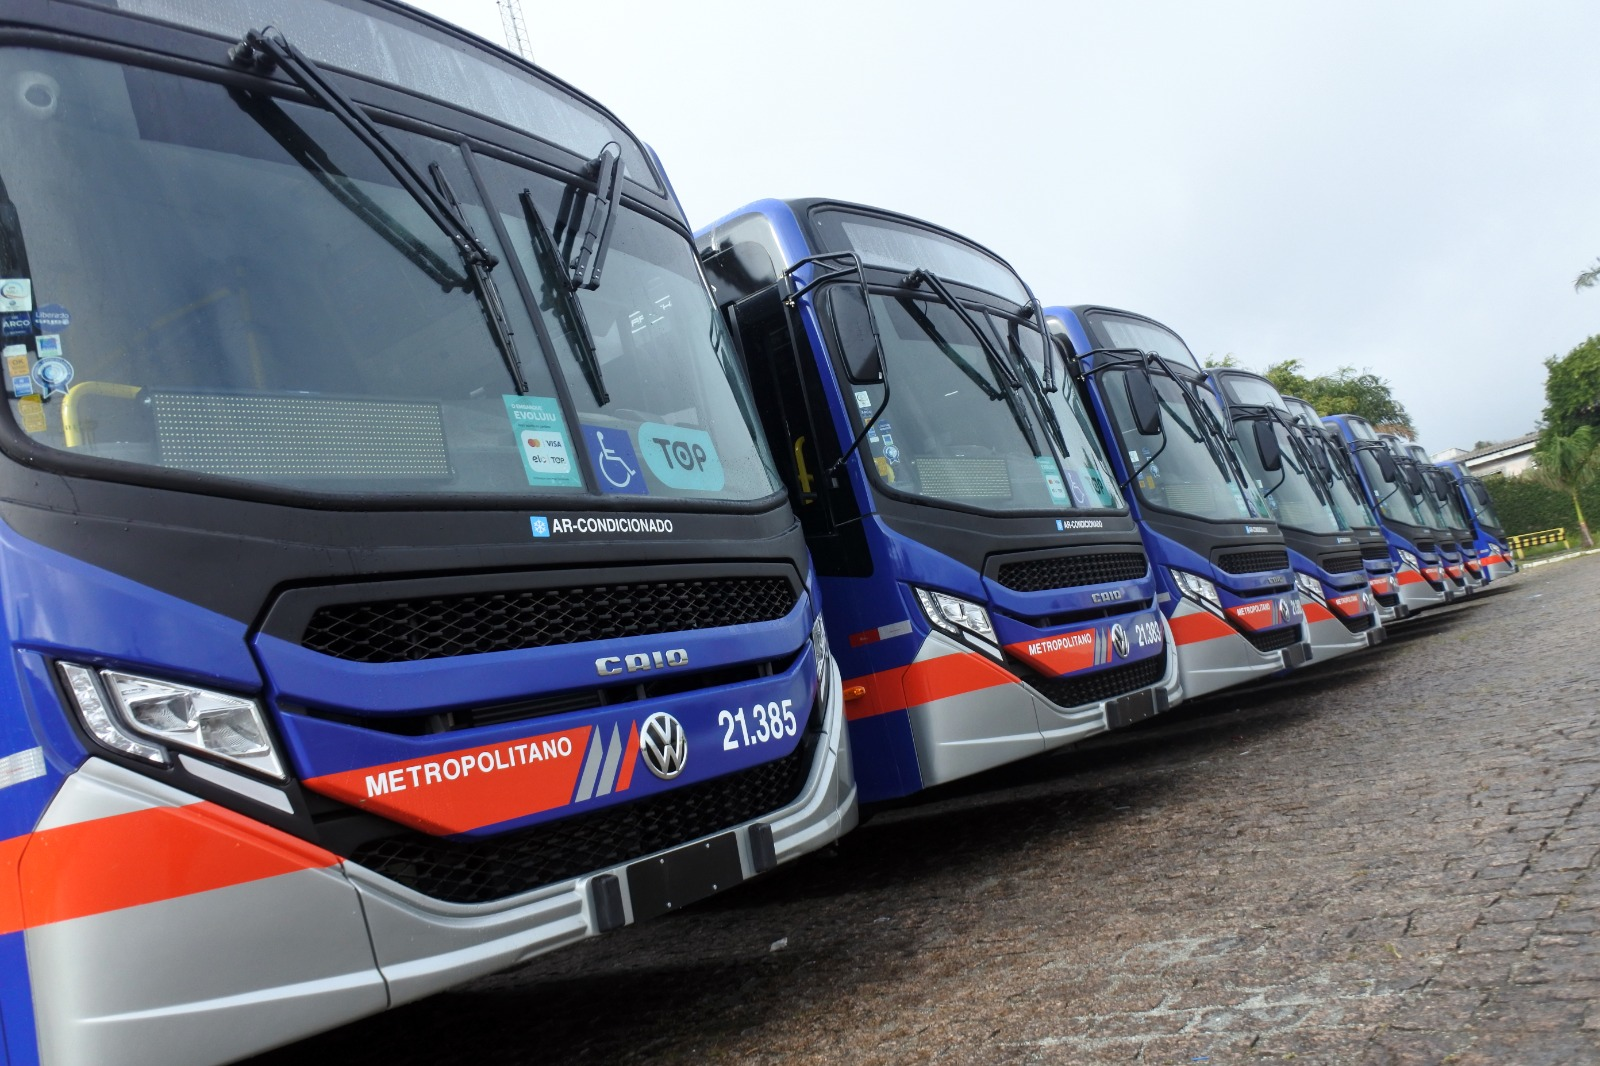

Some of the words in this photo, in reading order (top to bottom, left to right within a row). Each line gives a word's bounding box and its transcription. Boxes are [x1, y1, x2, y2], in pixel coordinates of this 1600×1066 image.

[514, 410, 557, 422] EVOLUIU
[550, 456, 565, 464] TOP
[652, 437, 707, 472] TOP
[552, 517, 673, 533] AR-CONDICIONADO
[1028, 633, 1092, 655] METROPOLITANO
[1135, 620, 1161, 647] 21.383
[595, 648, 689, 676] CAIO
[718, 698, 797, 751] 21.385
[365, 736, 573, 798] METROPOLITANO
